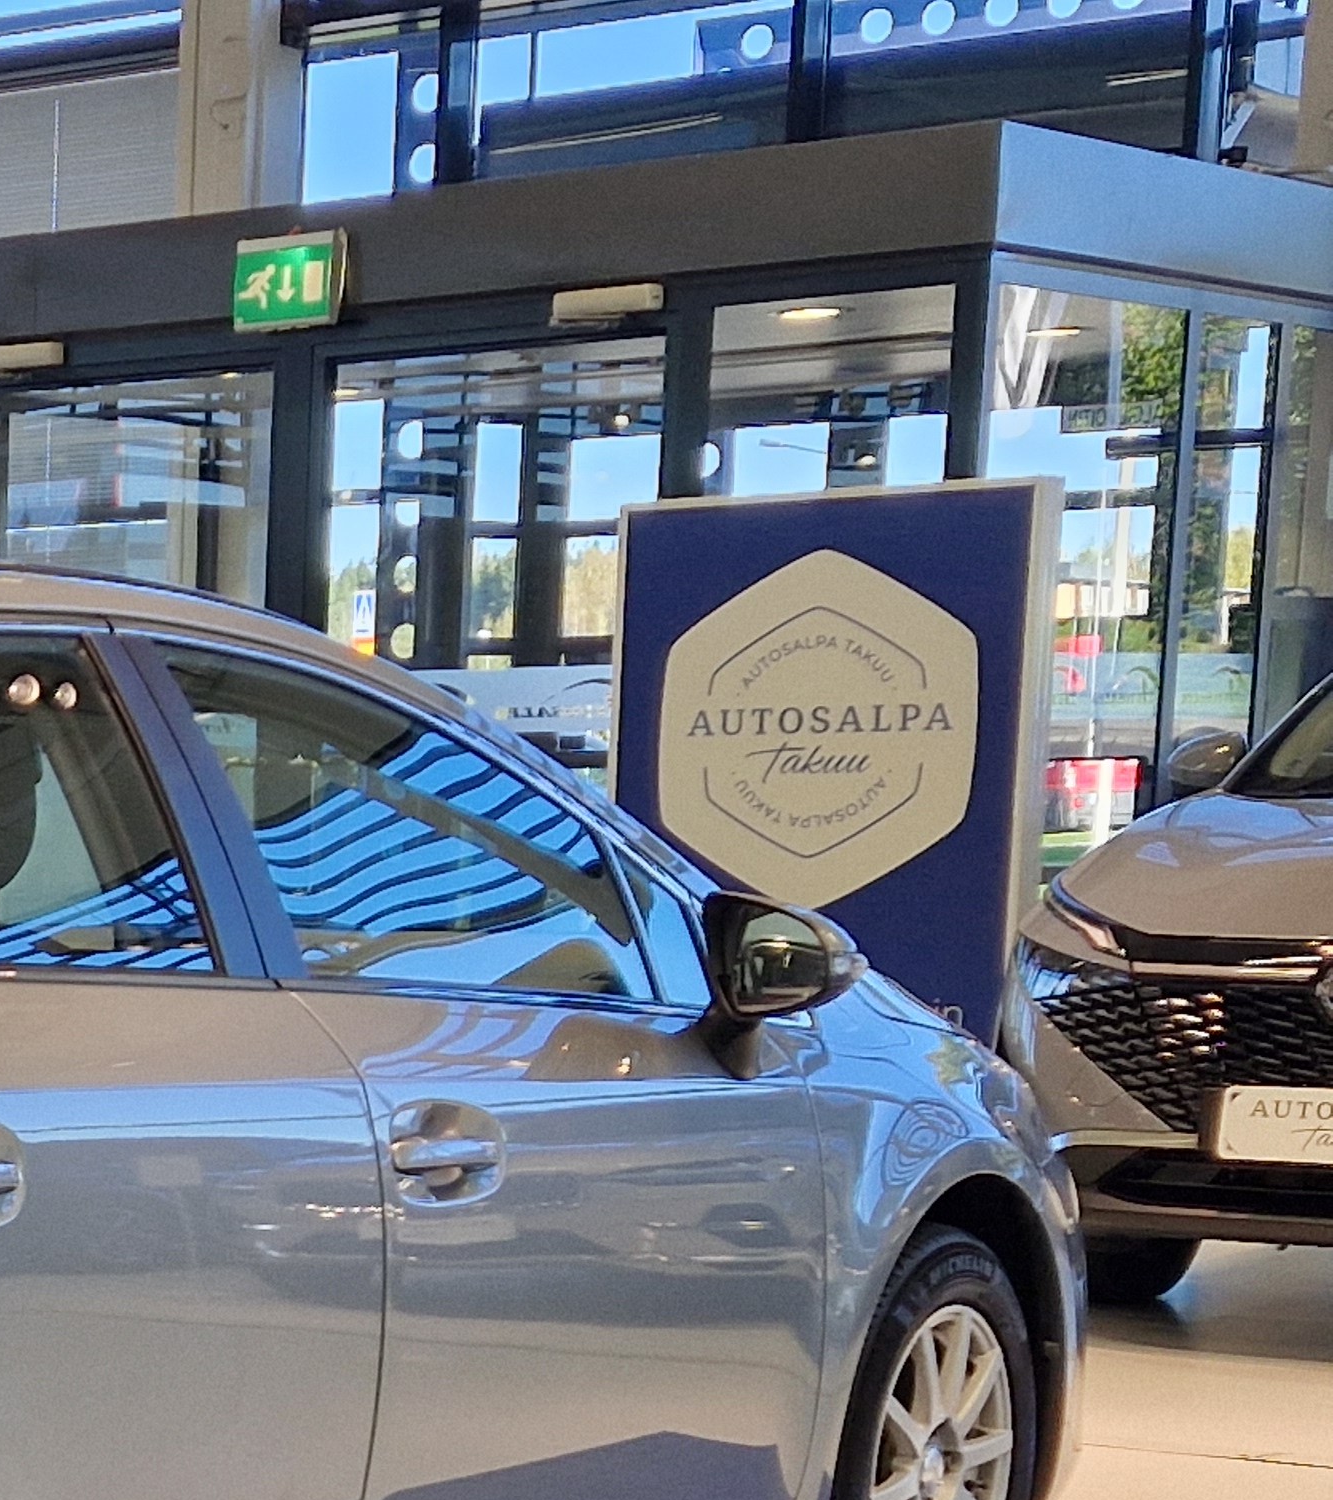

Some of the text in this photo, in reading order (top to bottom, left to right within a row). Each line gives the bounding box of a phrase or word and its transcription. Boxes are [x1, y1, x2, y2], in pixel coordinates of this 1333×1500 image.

[741, 634, 895, 690] AUTOSALPA TAKUU
[687, 702, 954, 737] AUTOSALPA
[745, 741, 871, 784] Takuu
[734, 777, 887, 829] AUTOSALPA TAKUU
